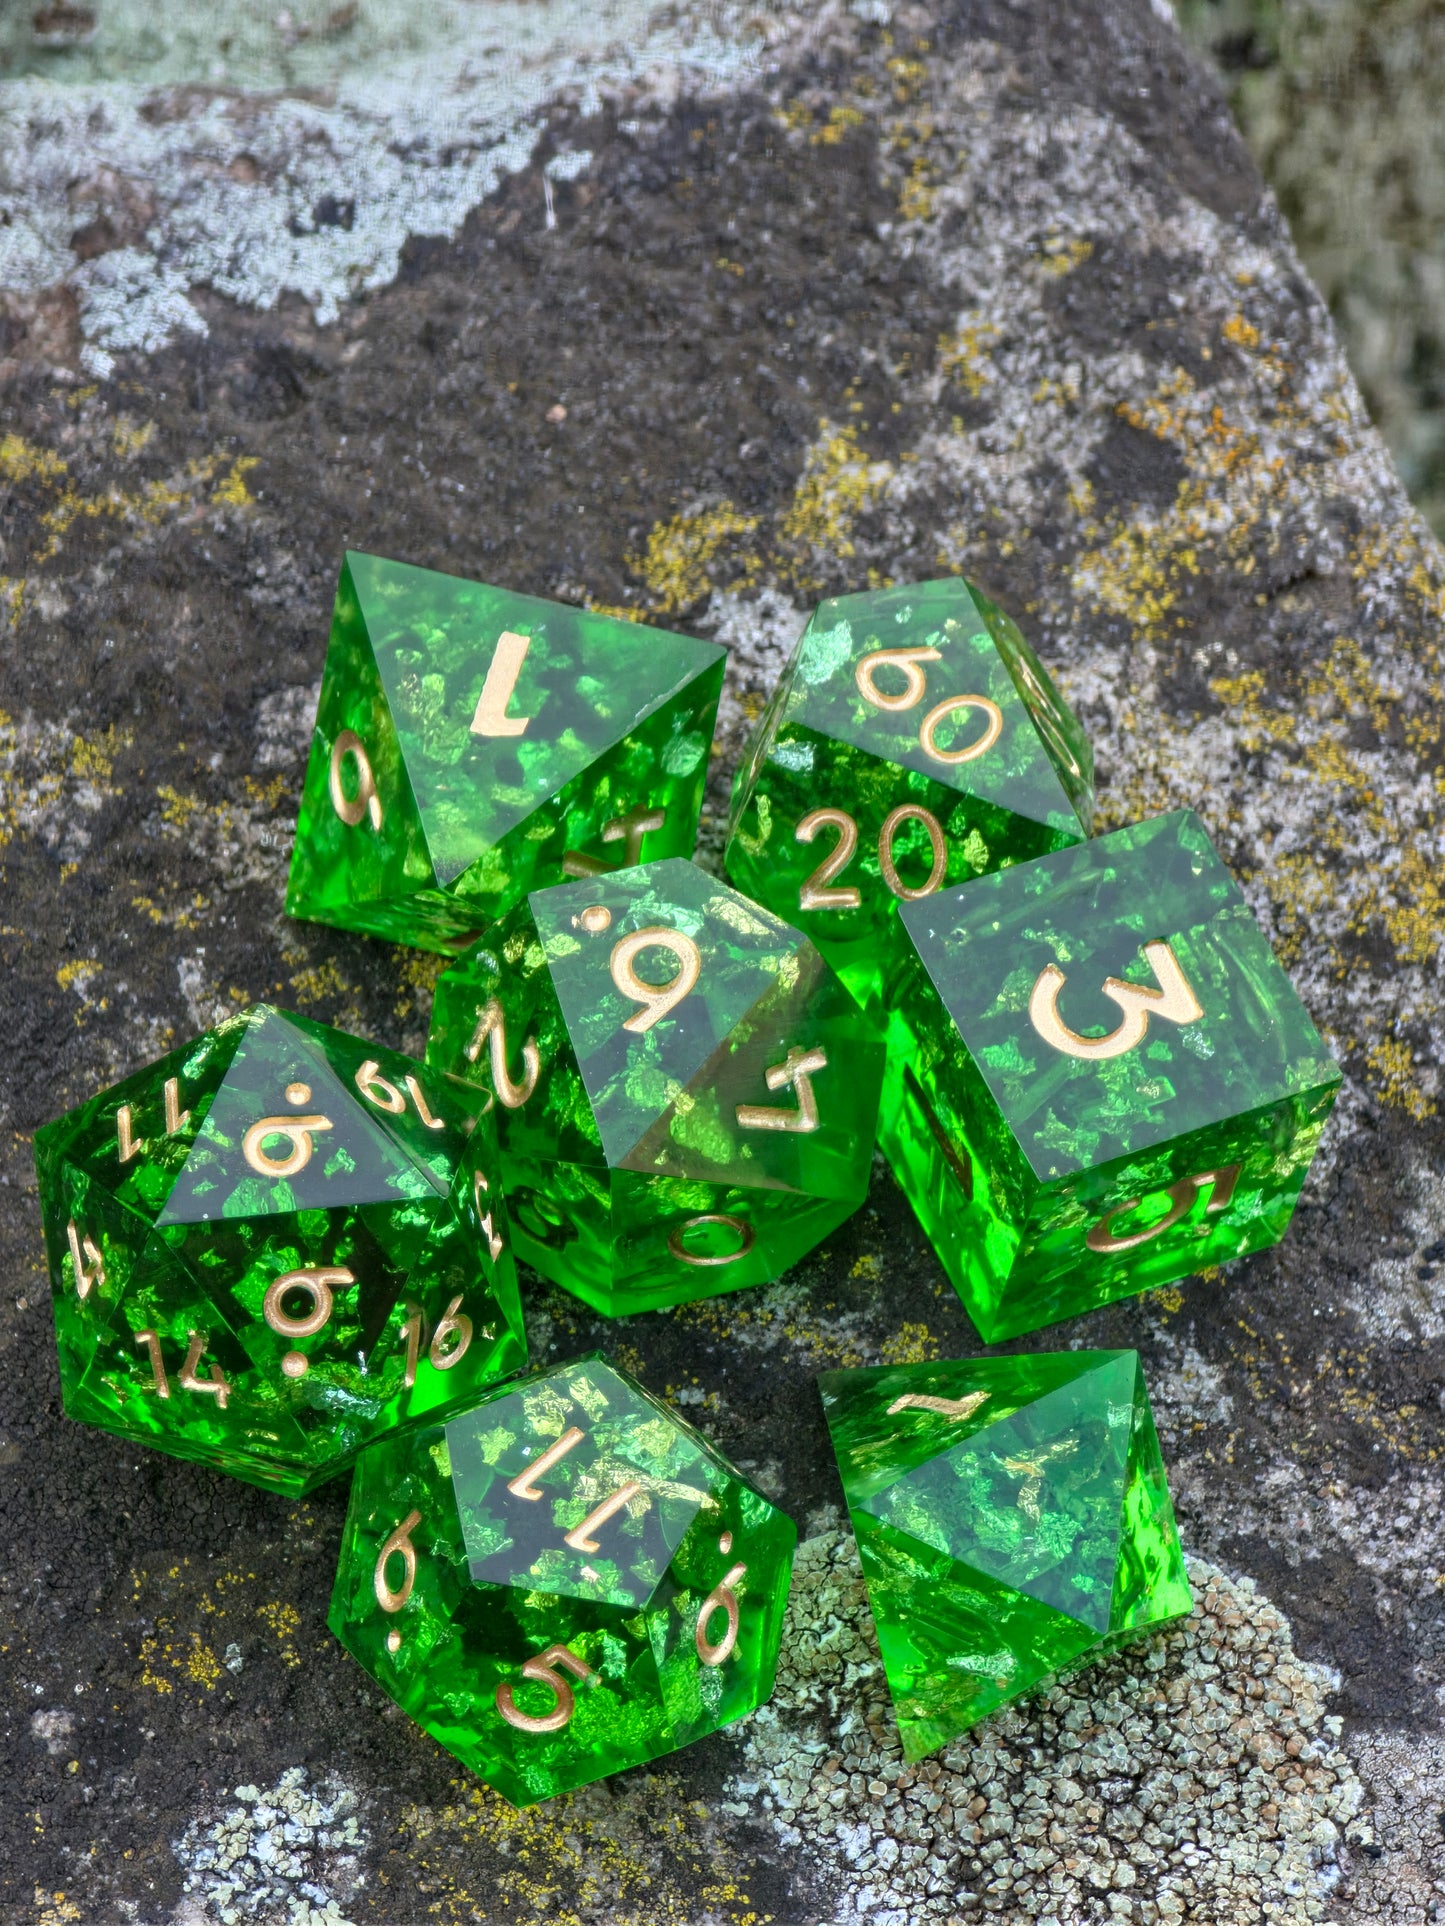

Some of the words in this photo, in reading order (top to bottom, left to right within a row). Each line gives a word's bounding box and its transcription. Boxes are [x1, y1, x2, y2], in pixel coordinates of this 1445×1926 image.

[795, 804, 948, 911] 20
[1028, 939, 1205, 1060] 3
[135, 1330, 231, 1409] 14
[400, 1293, 473, 1388] 16
[496, 1644, 602, 1732] 5
